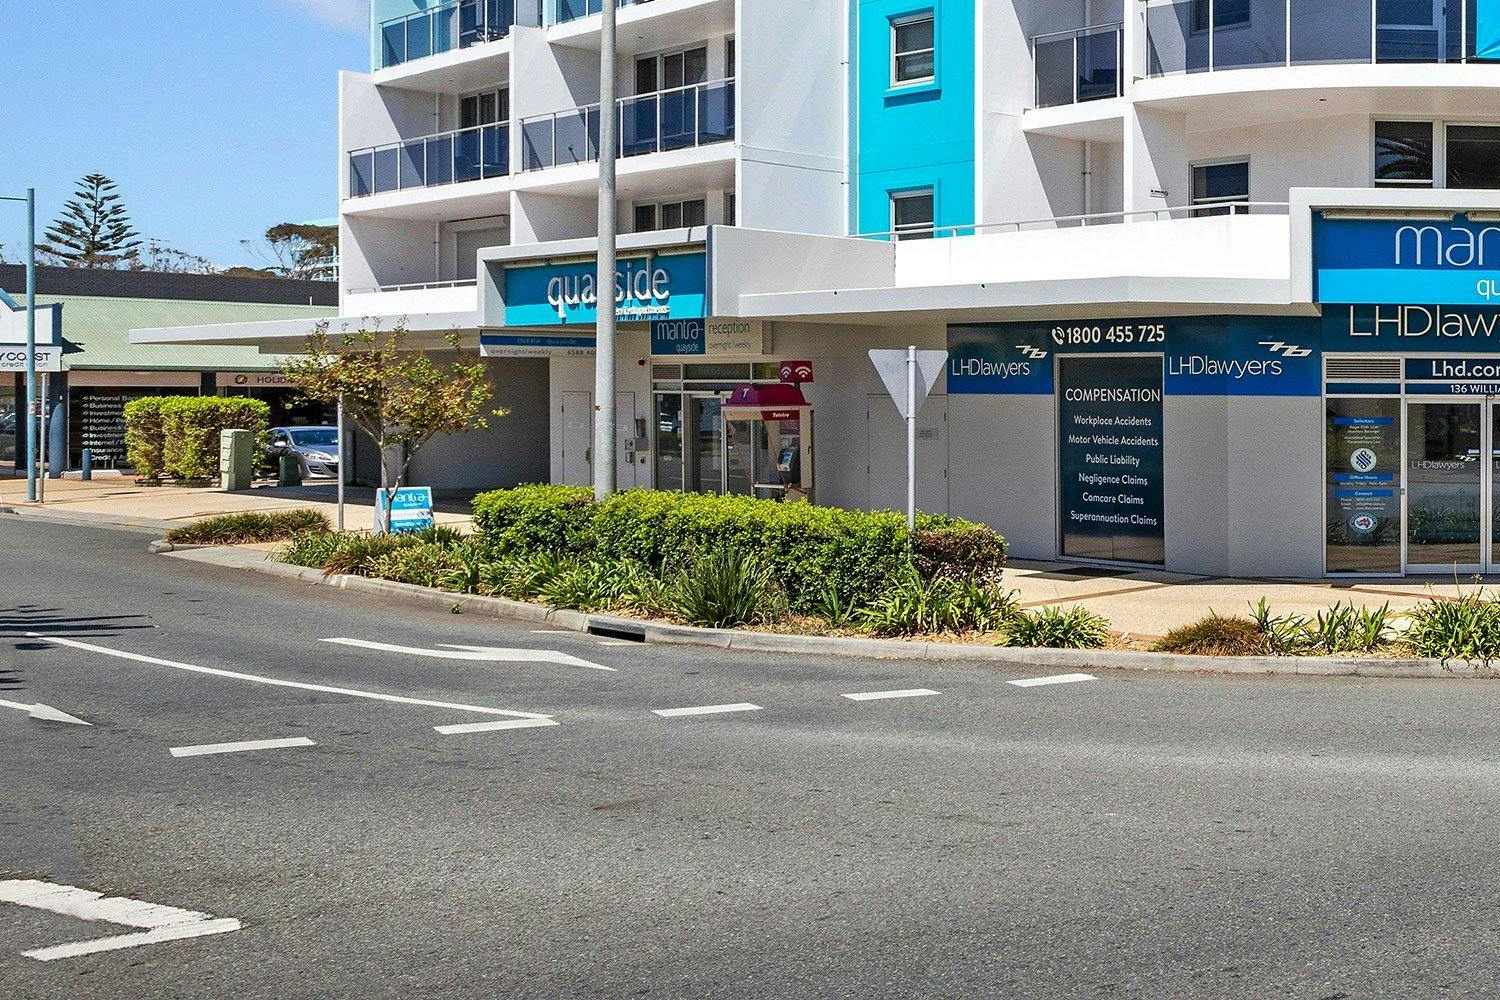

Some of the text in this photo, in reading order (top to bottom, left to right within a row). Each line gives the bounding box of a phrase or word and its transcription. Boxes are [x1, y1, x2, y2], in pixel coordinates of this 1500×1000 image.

[548, 261, 670, 318] quaside
[657, 320, 704, 340] mantra
[708, 322, 750, 336] reception
[1066, 324, 1166, 344] 1800 455 725
[676, 343, 699, 353] quayside
[952, 356, 1031, 380] LHDlawyers
[1169, 356, 1283, 380] LHDlawyers
[1065, 388, 1160, 402] COMPENSATION
[1450, 384, 1468, 394] 136
[1074, 415, 1152, 427] Workplace Accidents
[1068, 434, 1158, 446] Motor Vehicle Accidents
[1086, 454, 1140, 468] Public Liability
[1412, 460, 1465, 470] LHDlawyers
[1078, 472, 1148, 486] Negligence Claims
[394, 492, 428, 502] antra
[1082, 492, 1144, 505] Comcare Claims
[1070, 510, 1157, 526] Superannuation Claims
